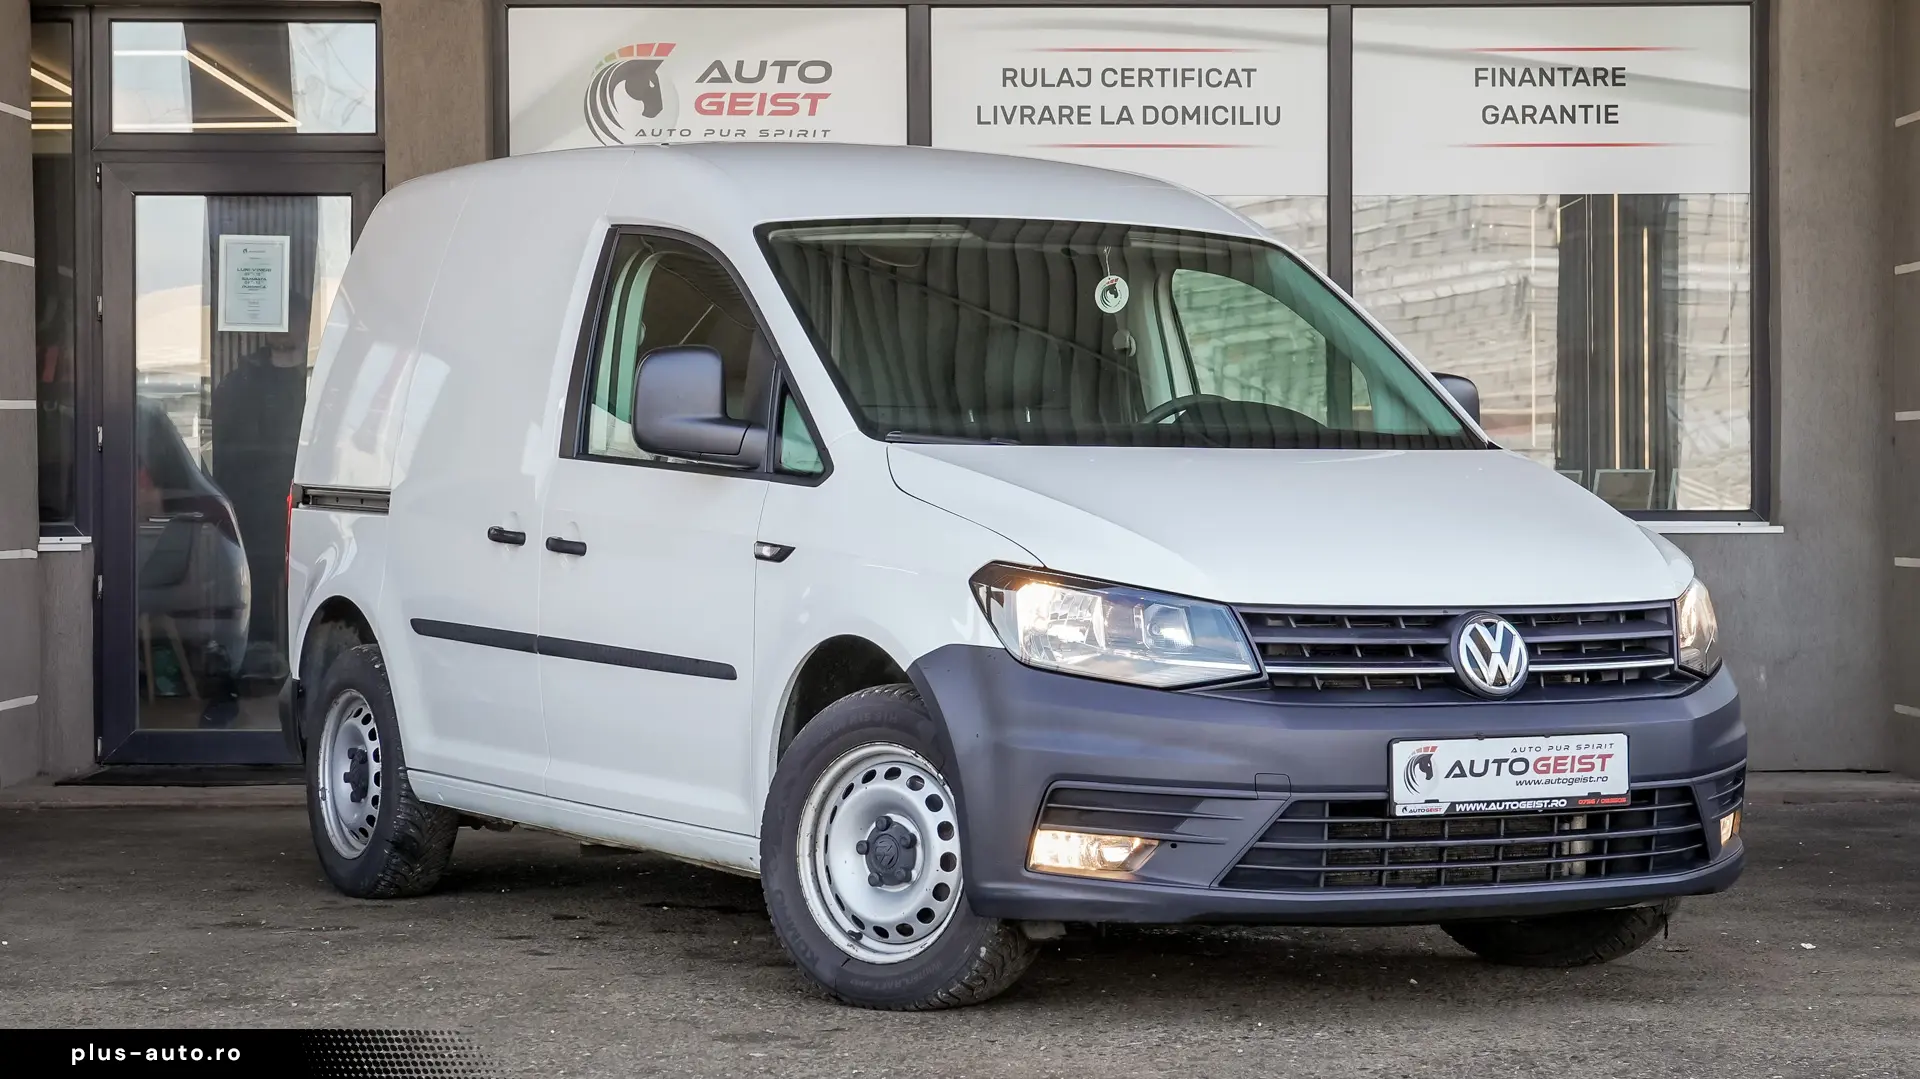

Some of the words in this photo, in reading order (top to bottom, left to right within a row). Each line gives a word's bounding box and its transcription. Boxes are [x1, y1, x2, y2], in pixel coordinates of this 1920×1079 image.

[694, 60, 833, 84] AUTO
[1002, 68, 1092, 88] RULAJ
[1100, 67, 1257, 88] CERTIFICAT
[1474, 67, 1626, 87] FINANTARE
[694, 92, 832, 116] GEIST
[976, 105, 1092, 125] LIVRARE
[1100, 105, 1135, 125] LA
[1142, 105, 1281, 126] DOMICILIU
[1481, 104, 1619, 125] GARANTIE
[635, 128, 691, 137] AUTO
[704, 128, 747, 138] PUR
[759, 128, 831, 138] SPIRIT
[1511, 745, 1542, 753] AUTO
[1515, 775, 1609, 787] www.autogeist.ro
[1455, 799, 1567, 812] WWW.AUTOGEIST.RO
